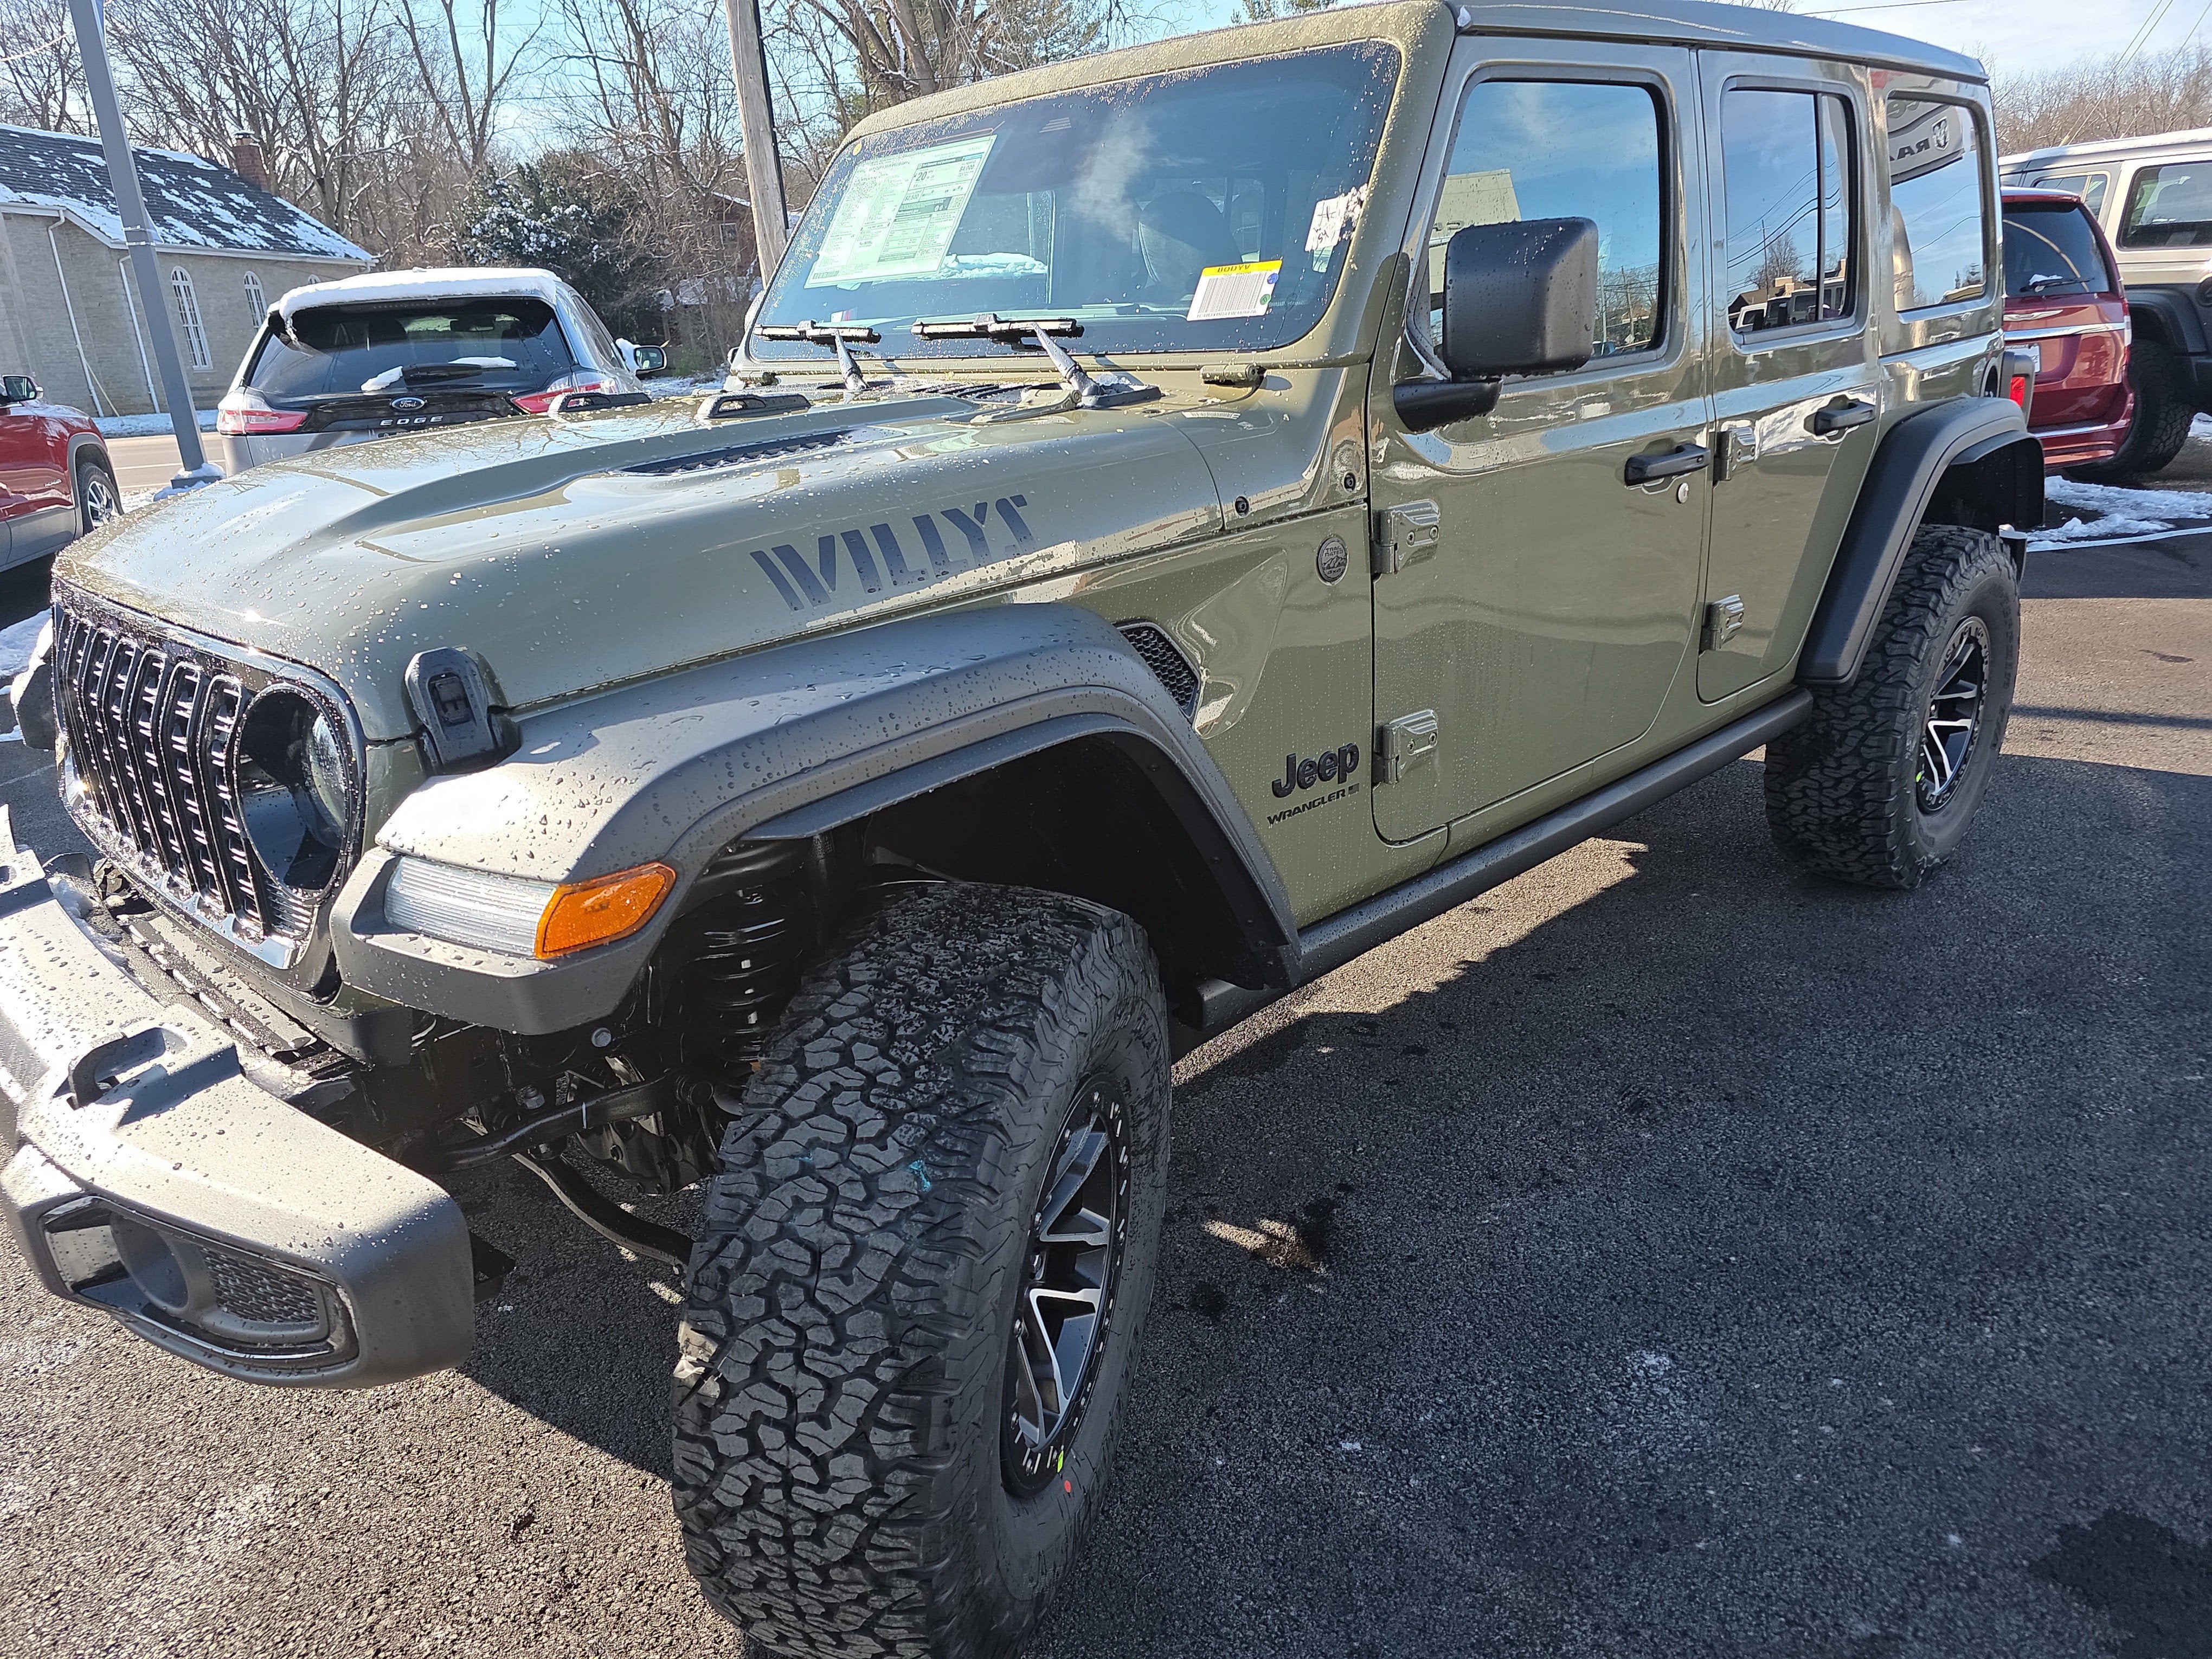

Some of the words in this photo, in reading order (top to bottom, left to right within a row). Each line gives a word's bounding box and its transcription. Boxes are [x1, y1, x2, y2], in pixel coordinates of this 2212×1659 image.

[400, 400, 417, 408] Ford
[380, 416, 443, 426] EDGE
[1271, 743, 1360, 799] Jeep
[1266, 788, 1346, 826] WRANGLER
